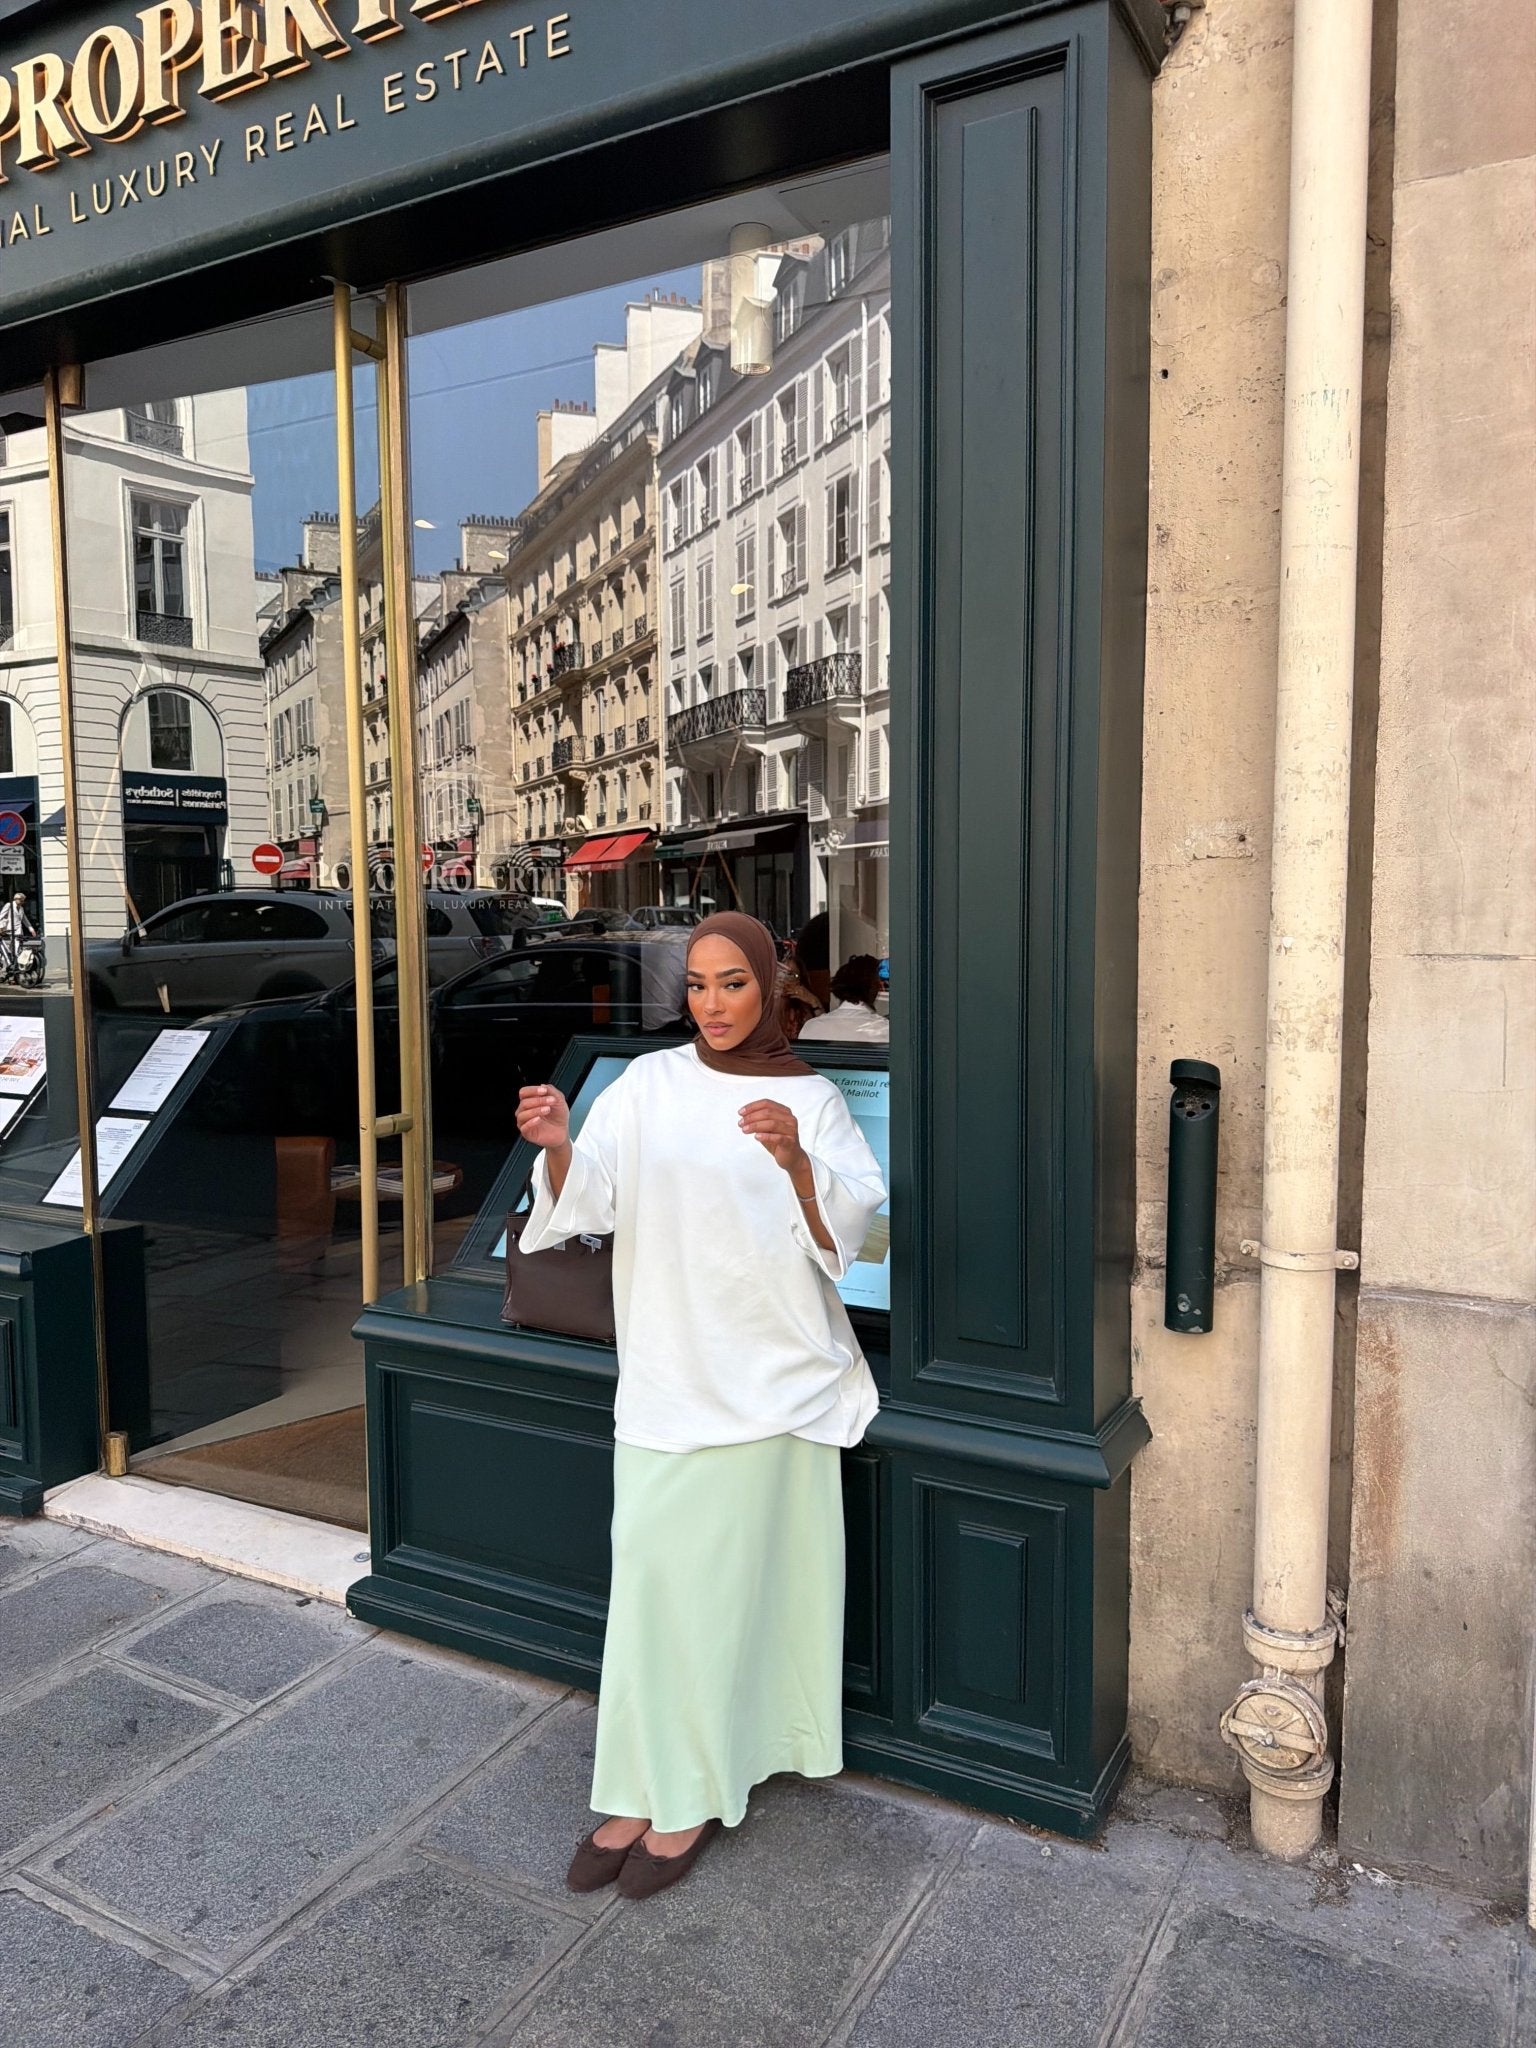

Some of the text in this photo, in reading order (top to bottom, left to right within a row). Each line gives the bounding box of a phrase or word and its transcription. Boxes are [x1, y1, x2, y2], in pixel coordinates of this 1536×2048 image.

[0, 13, 571, 247] AL LUXURY REAL ESTATE
[443, 900, 492, 910] LUXURY
[500, 901, 529, 910] REAL
[840, 1078, 878, 1088] familial
[846, 1089, 880, 1098] Maillot
